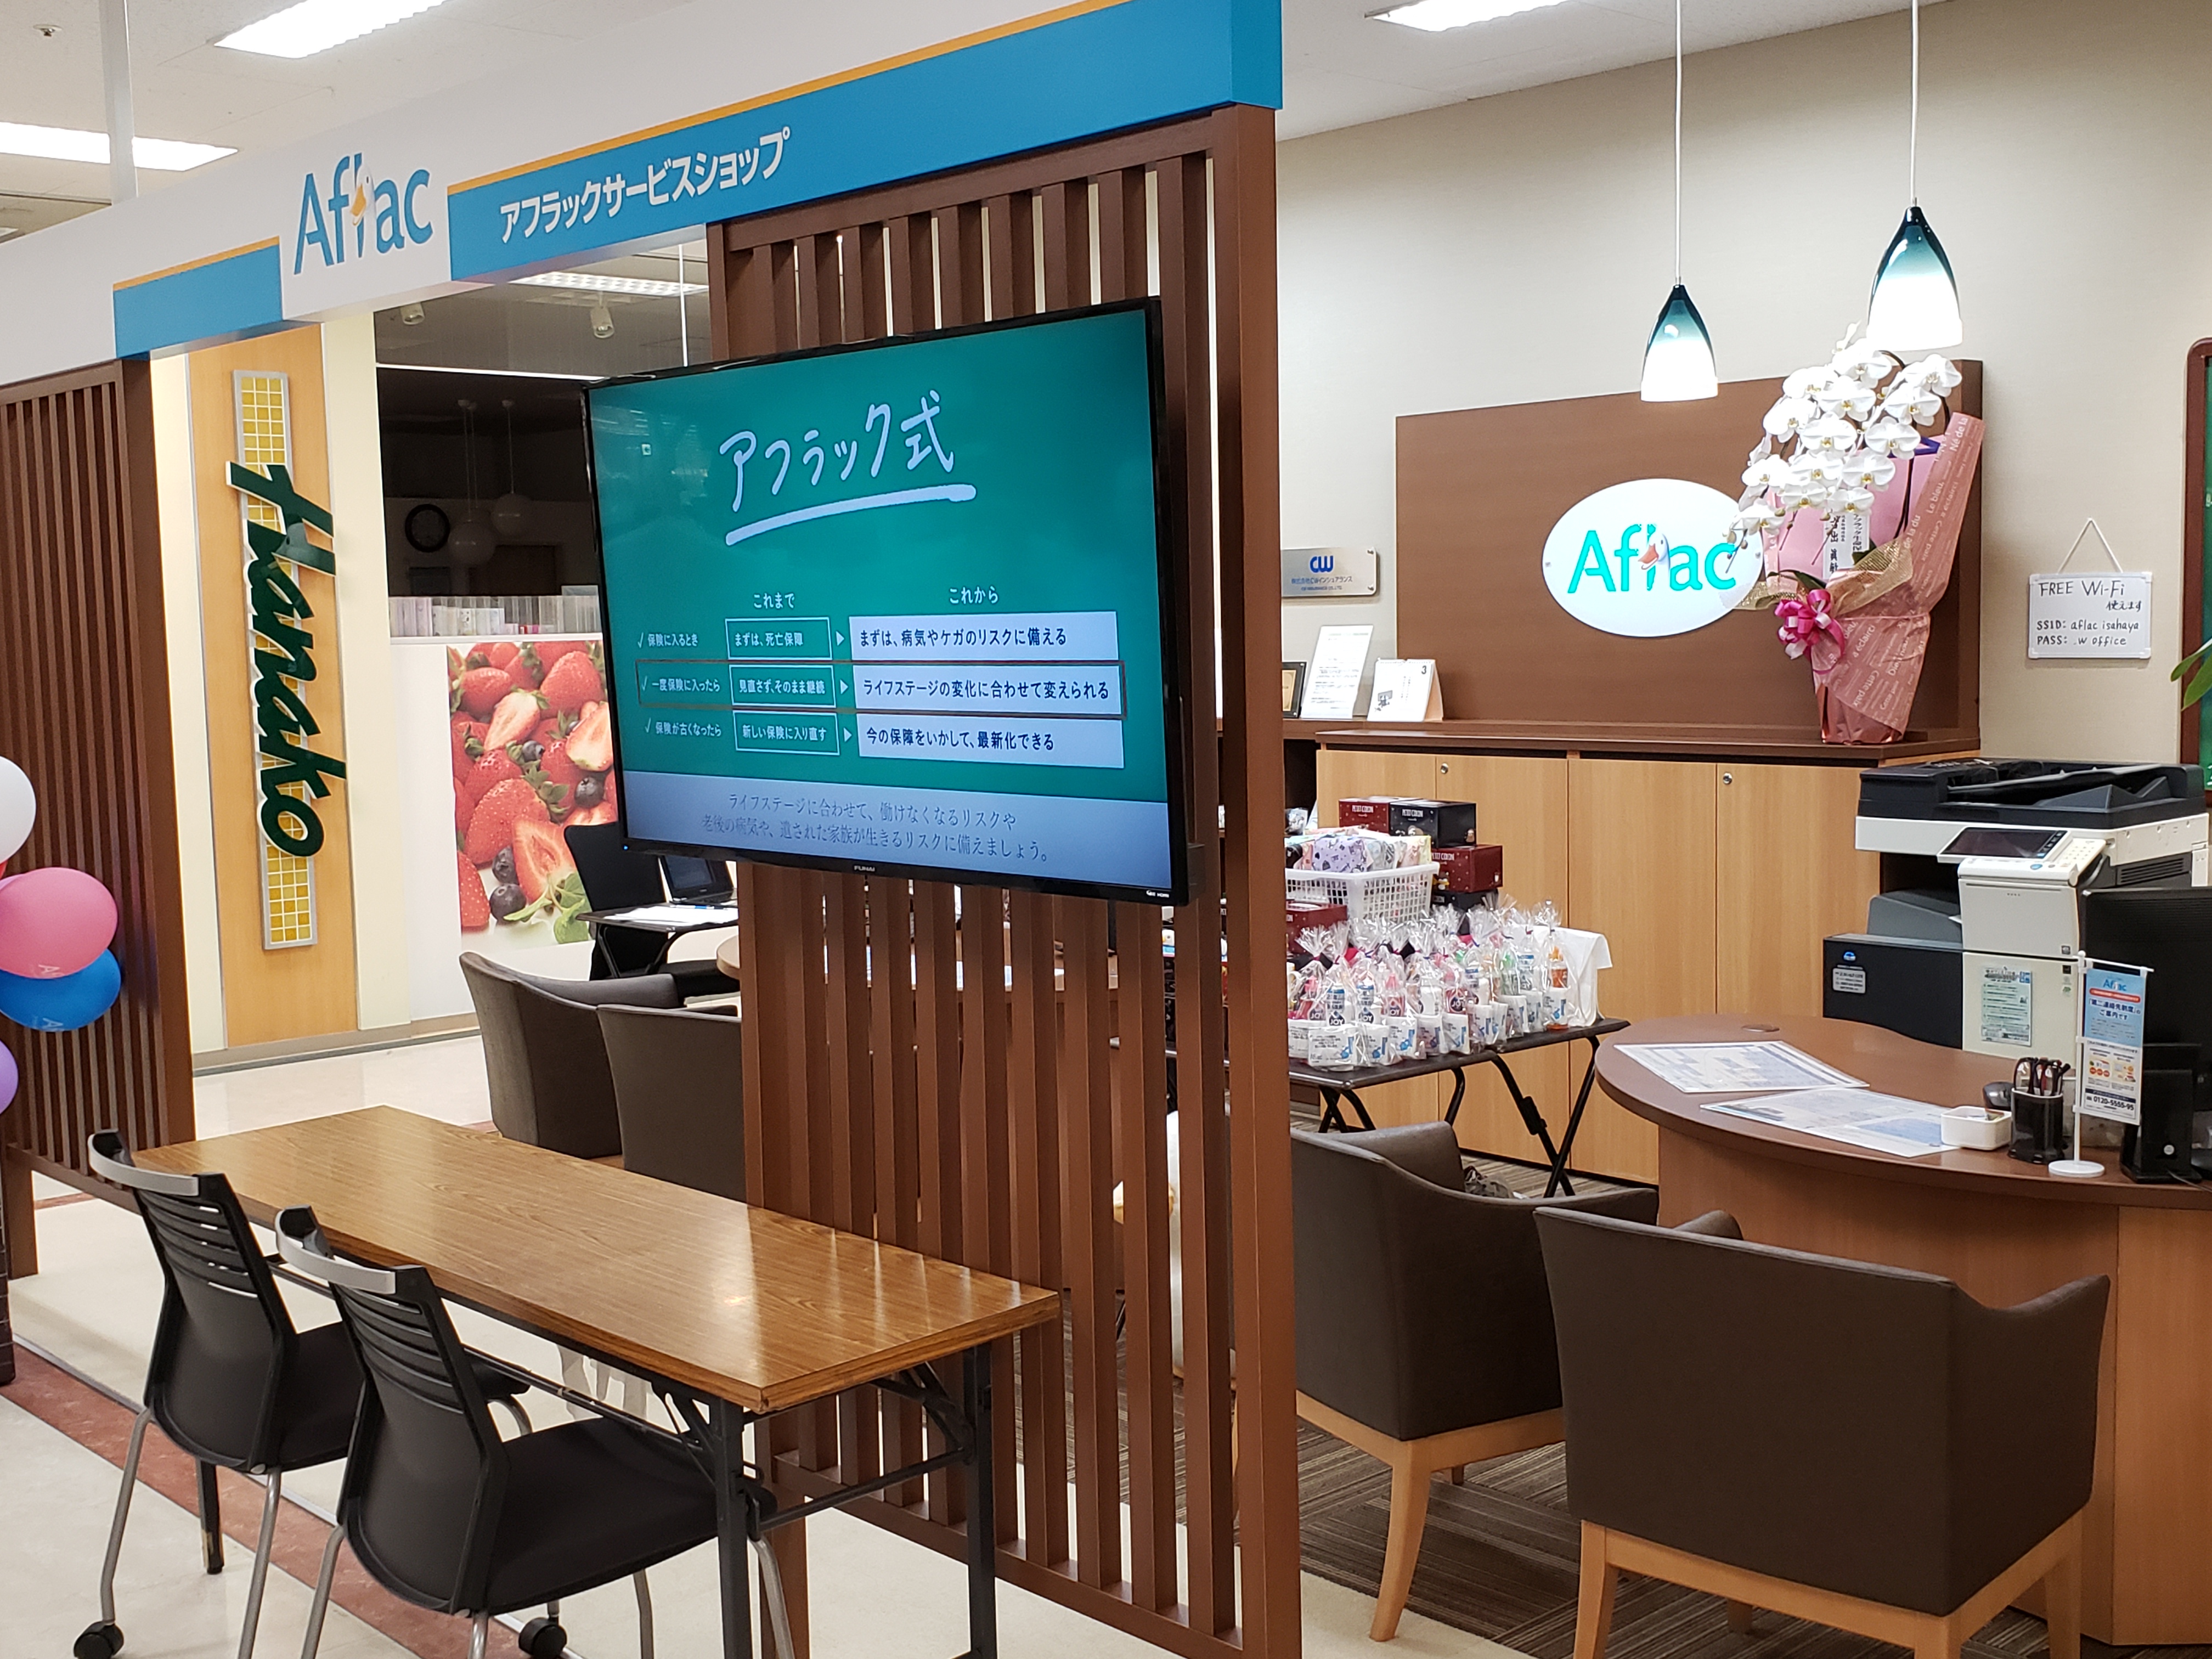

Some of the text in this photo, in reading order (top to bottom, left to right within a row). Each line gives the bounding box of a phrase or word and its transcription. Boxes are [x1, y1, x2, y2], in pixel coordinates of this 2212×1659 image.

[499, 125, 791, 244] アフラックサービスショップ
[294, 153, 433, 275] Aflac
[719, 390, 954, 512] アフラック式
[1567, 523, 1736, 594] Aflac
[949, 586, 999, 604] これから
[2038, 580, 2125, 598] FREE Wi-Fi
[753, 592, 795, 609] これまで
[2036, 618, 2139, 633] SSID: aflac isahaya
[648, 634, 698, 647] 保険に入るとき
[735, 632, 804, 647] まずは、死亡保障
[860, 627, 1067, 647] まずは、病気やケガのリスクに備える
[2037, 635, 2068, 645] PASS:
[2092, 636, 2127, 647] office
[225, 461, 347, 857] Hanako
[1421, 665, 1427, 675] 3
[652, 679, 721, 692] 一度保険に入ったら
[739, 679, 826, 695] 見直さず、そのまま継続
[863, 679, 1109, 700] ライフステージの変化に合わせて変えられる
[656, 721, 722, 737] 保険が古くなったら
[742, 724, 827, 742] 新しい保険に入り直す
[866, 726, 1054, 751] 今の保障をいかして、最新化できる
[729, 794, 1016, 831] ライフステージに合わせて、働けなくなるリスクや
[703, 814, 1047, 862] 老後の病気や、遺された家族が生きるリスクに備えましょう。
